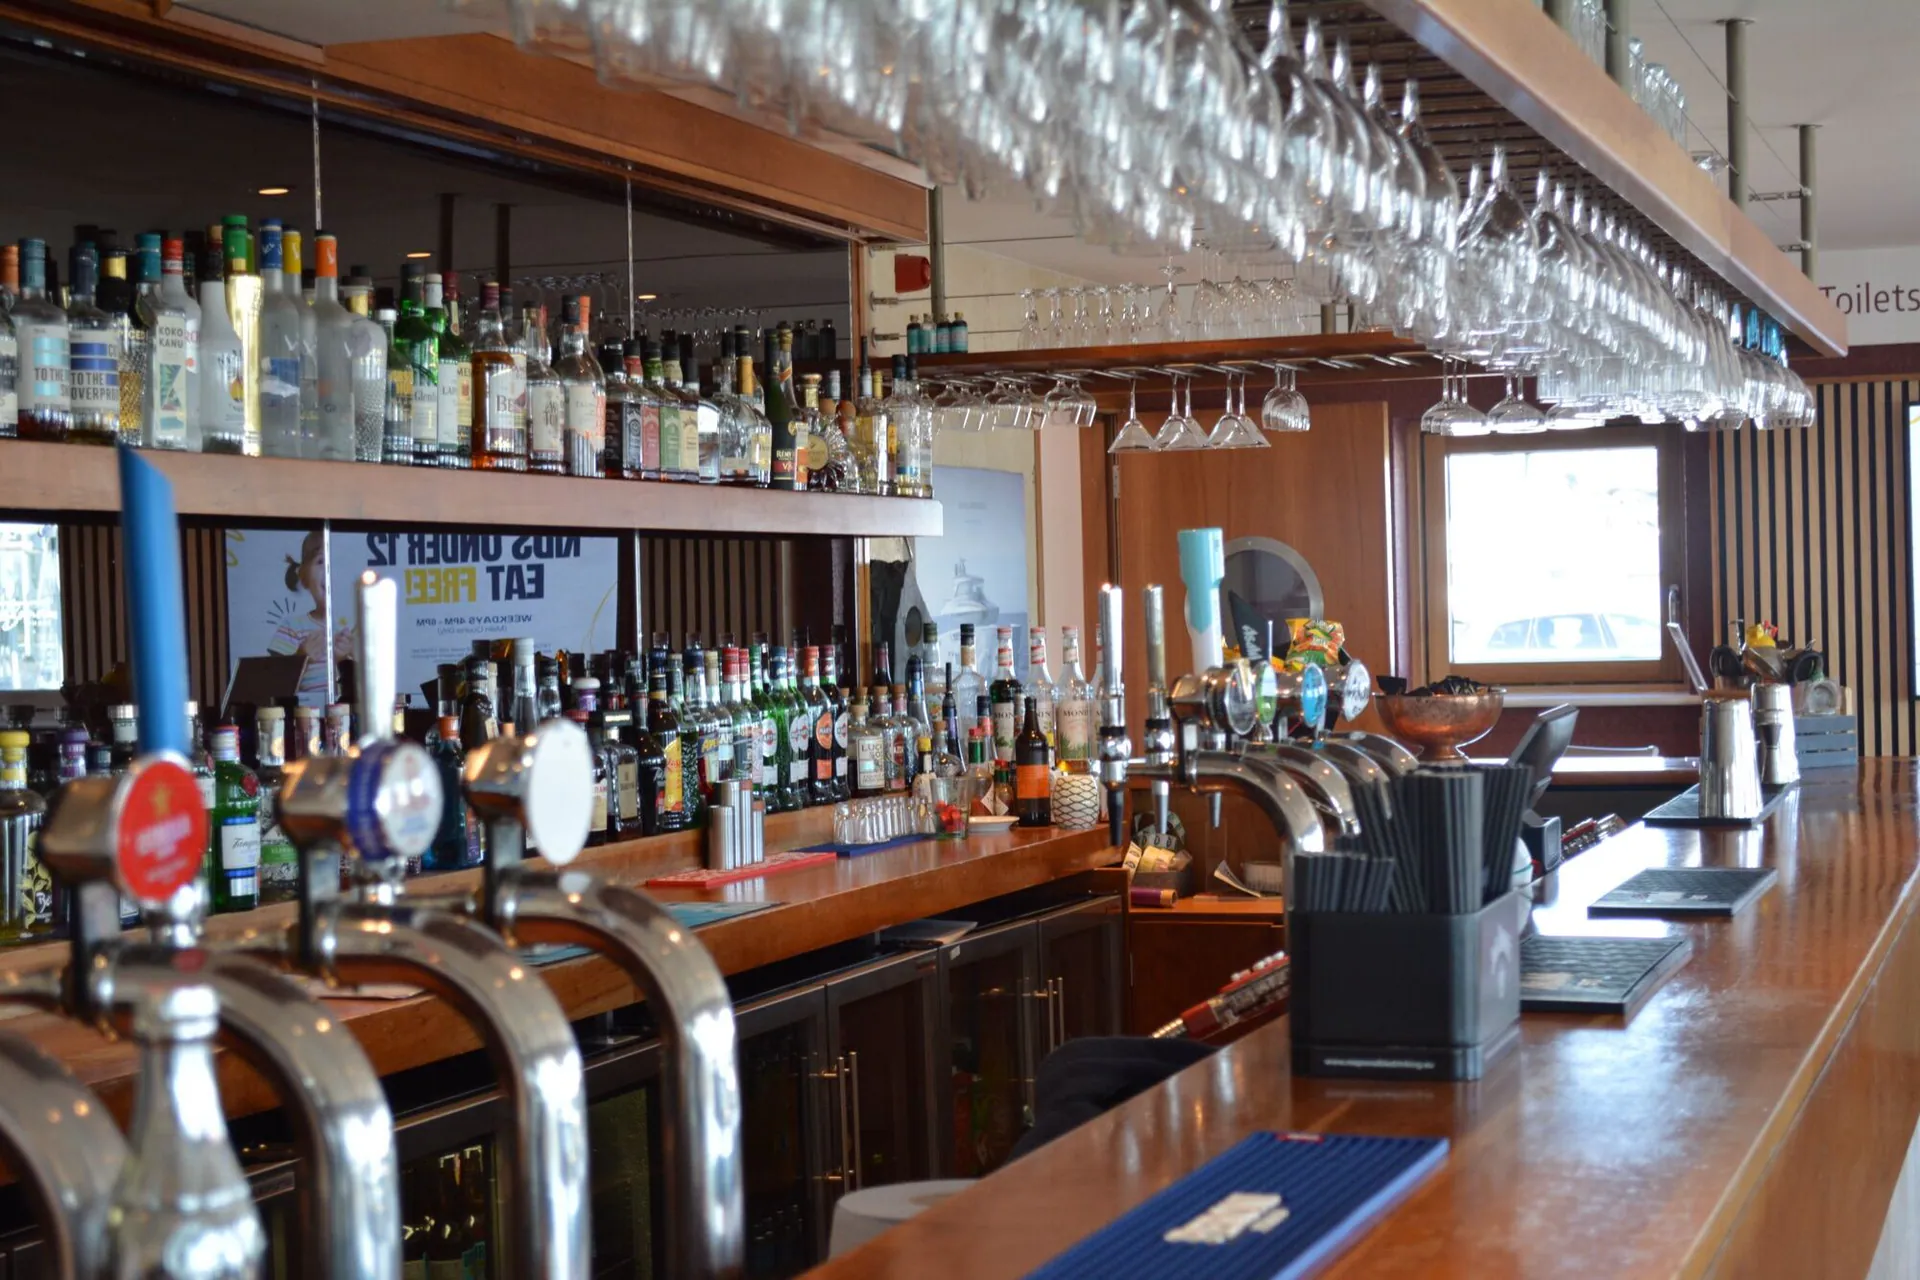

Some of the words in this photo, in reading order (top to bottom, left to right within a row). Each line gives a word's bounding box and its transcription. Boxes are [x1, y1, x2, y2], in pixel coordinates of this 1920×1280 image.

[1818, 281, 1920, 314] Toilets
[158, 326, 184, 338] KOKO
[158, 337, 184, 349] KANU
[35, 367, 48, 381] TO
[50, 368, 64, 382] THE
[70, 372, 84, 386] TO
[86, 373, 104, 386] THE
